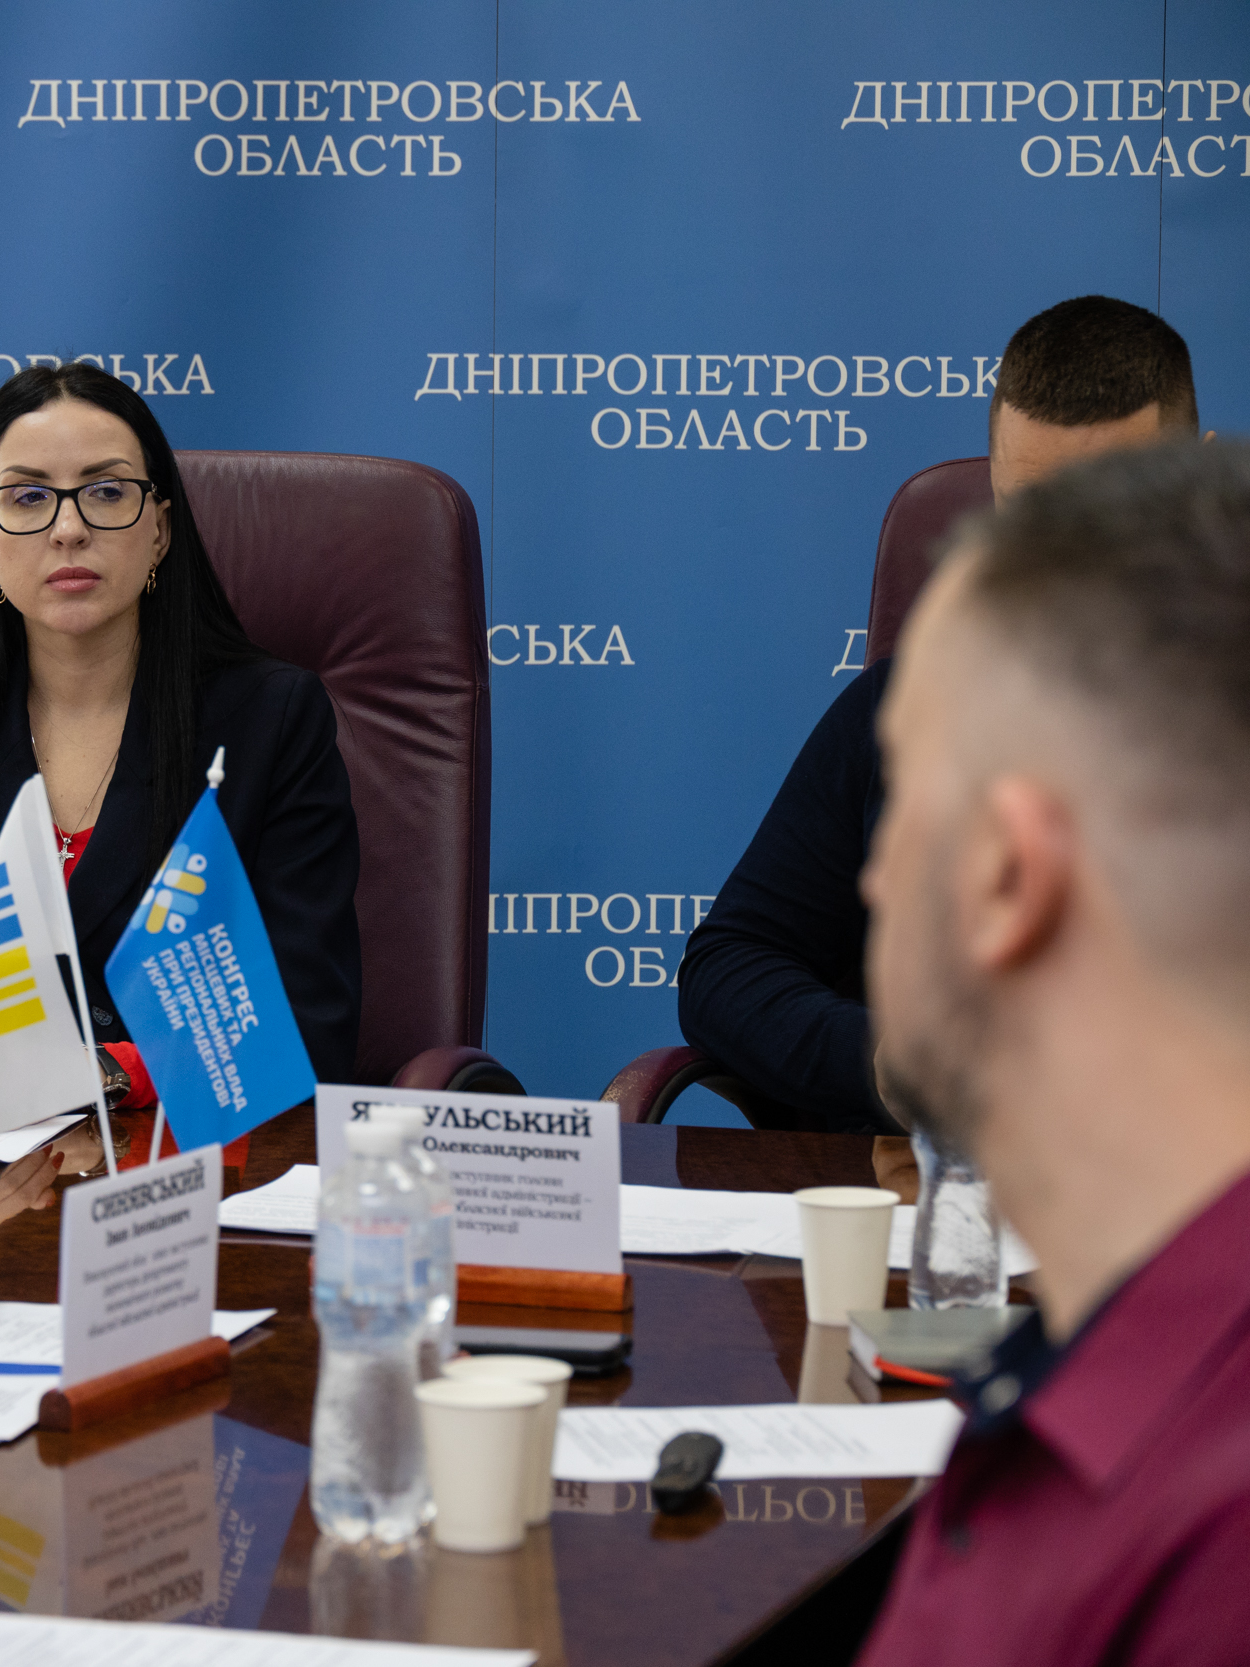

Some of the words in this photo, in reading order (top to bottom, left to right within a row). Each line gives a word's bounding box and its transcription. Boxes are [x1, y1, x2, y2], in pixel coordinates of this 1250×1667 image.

[18, 79, 641, 128] ДНІПРОПЕТРОВСЬКА
[841, 79, 1250, 130] ДНІПРОПЕТР
[194, 134, 462, 176] ОБЛАСТЬ
[1020, 135, 1250, 178] ОБЛАСТ
[415, 353, 1003, 402] ДНІПРОПЕТРОВСЬК
[591, 407, 868, 452] ОБЛАСТЬ
[141, 956, 185, 1031] УКРАЇНИ
[191, 932, 235, 1022] МІСЦЕВИХ
[227, 1020, 242, 1047] ТА
[207, 922, 258, 1033] КОНГРЕС
[158, 948, 185, 986] ПРИ
[175, 984, 231, 1109] ПРЕЗИДЕНТОВІ
[175, 940, 233, 1064] РЕГІОНАЛЬНИХ
[223, 1063, 248, 1113] ВЛАД
[351, 1101, 592, 1137] ЯУЛЬСЬКИЙ
[422, 1136, 581, 1161] Олександрович
